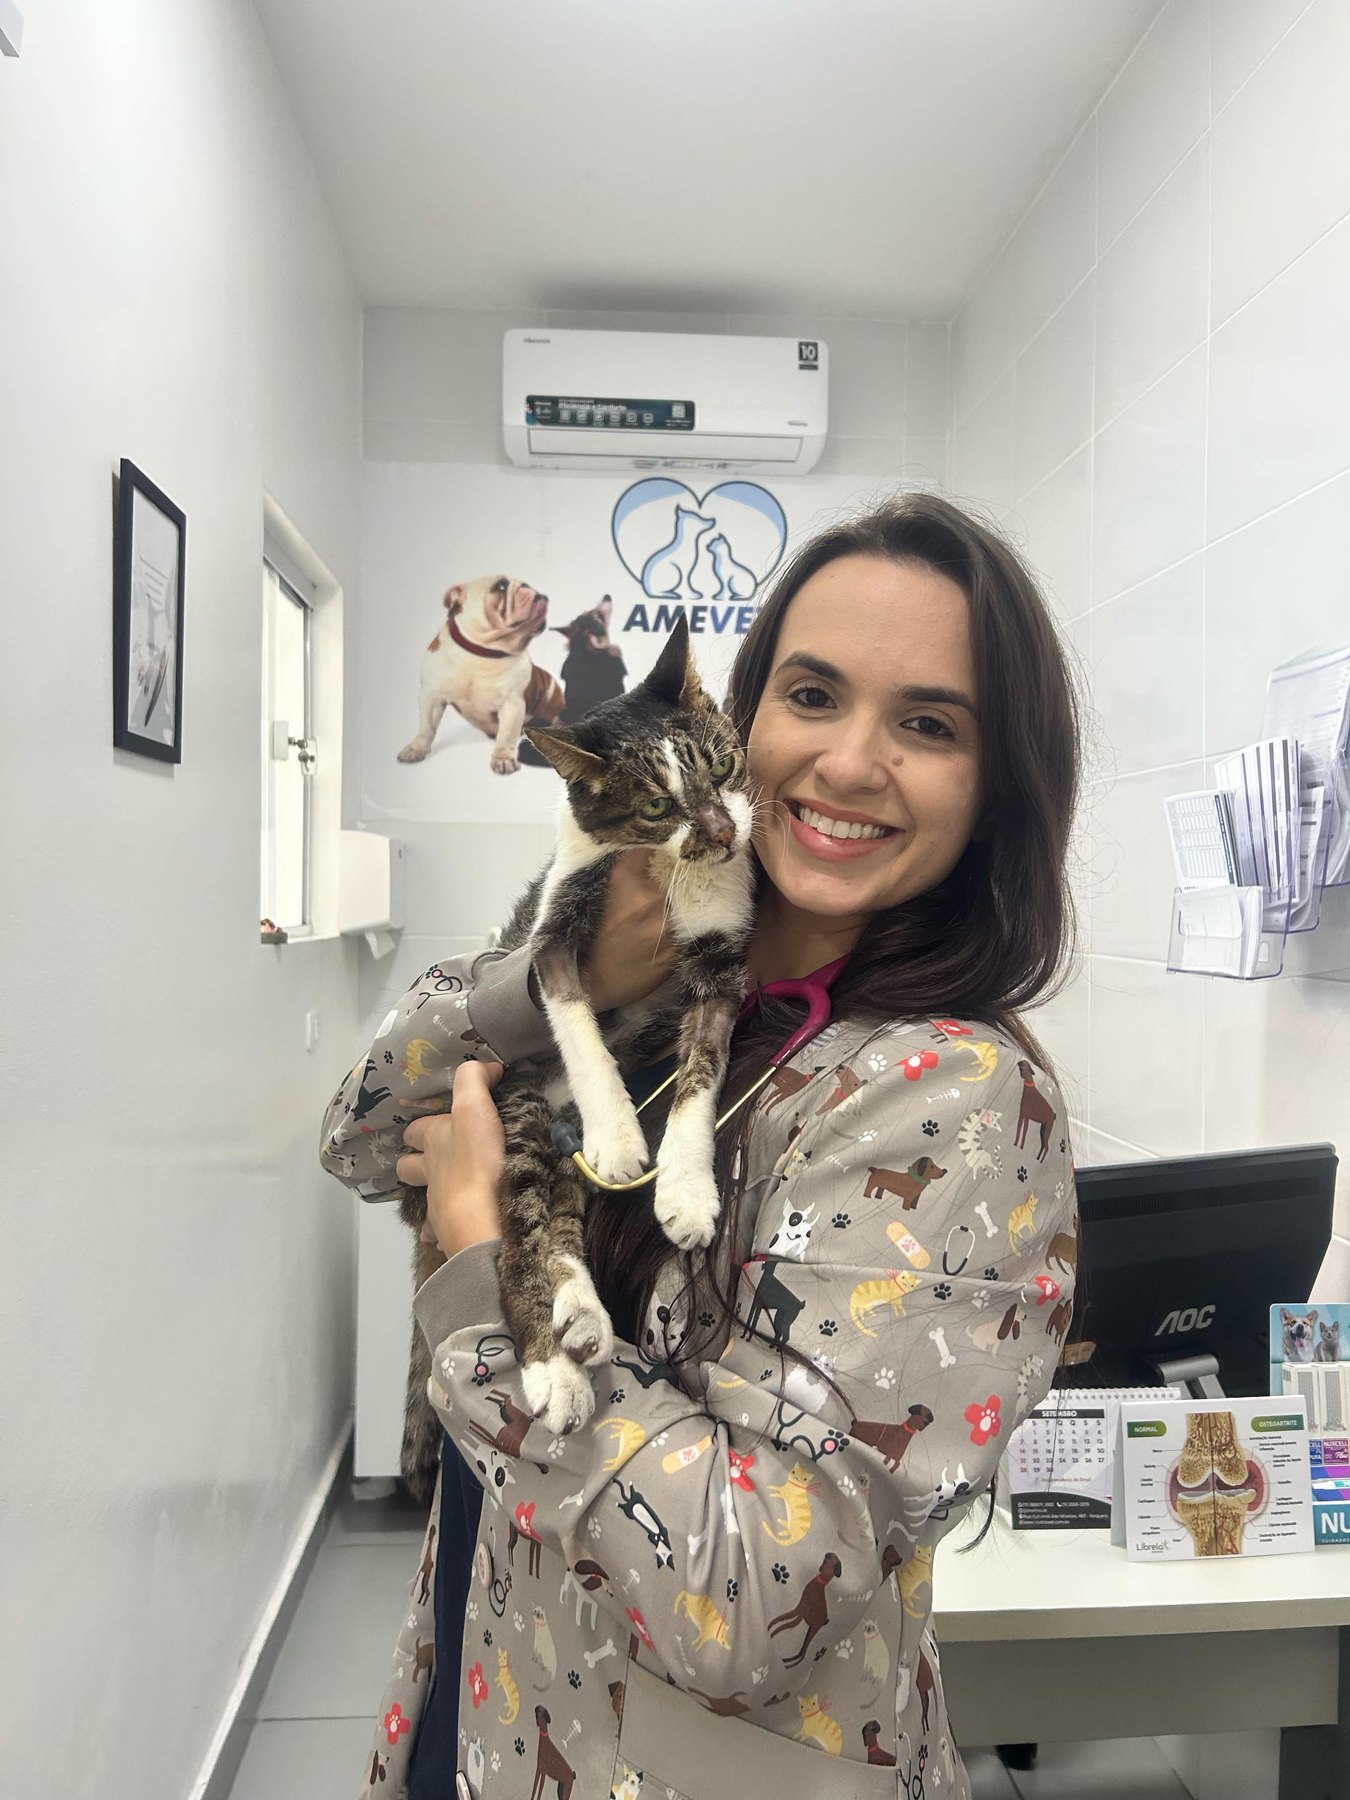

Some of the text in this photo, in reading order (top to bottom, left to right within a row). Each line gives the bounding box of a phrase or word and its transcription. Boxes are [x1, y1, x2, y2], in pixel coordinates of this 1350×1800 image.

[800, 344, 817, 360] 10
[622, 604, 760, 634] AMEVE
[1154, 1304, 1216, 1336] AOC
[1259, 1420, 1298, 1428] OSTEOARTRITE
[1136, 1542, 1164, 1551] Librela
